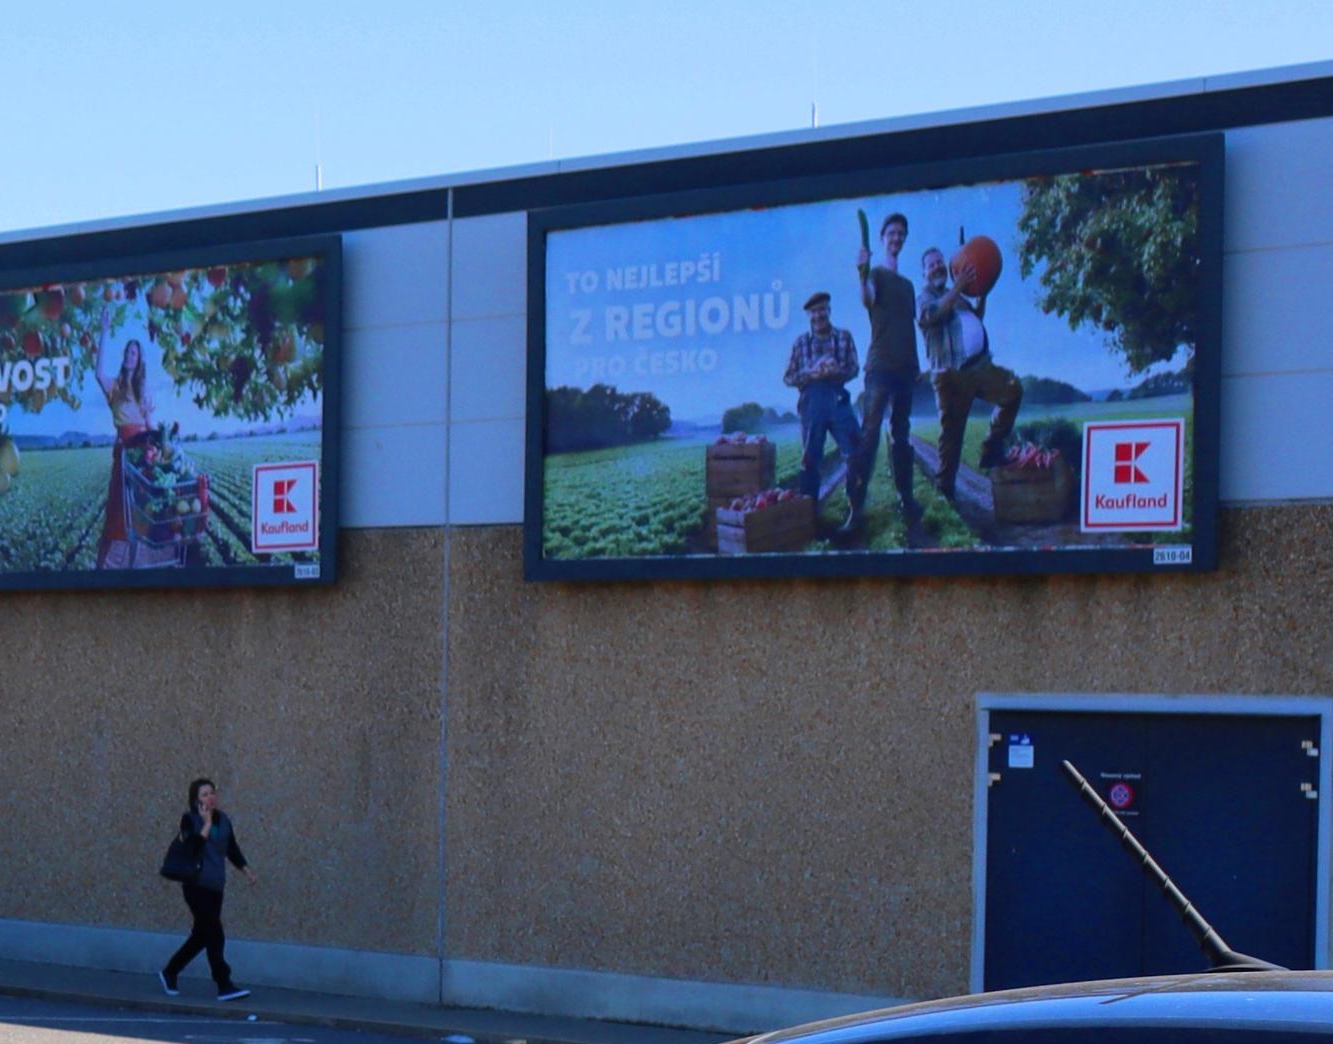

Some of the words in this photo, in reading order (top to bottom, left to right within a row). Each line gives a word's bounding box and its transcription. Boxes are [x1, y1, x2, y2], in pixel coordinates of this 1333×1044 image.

[565, 271, 599, 295] TO
[606, 252, 721, 292] NEJLEPŠÍ
[570, 309, 593, 346] Z
[605, 279, 791, 342] REGIONŮ
[579, 354, 628, 379] PRO
[635, 346, 718, 376] ČESKO
[1095, 492, 1168, 509] Kaufland
[261, 520, 310, 535] Kaufland
